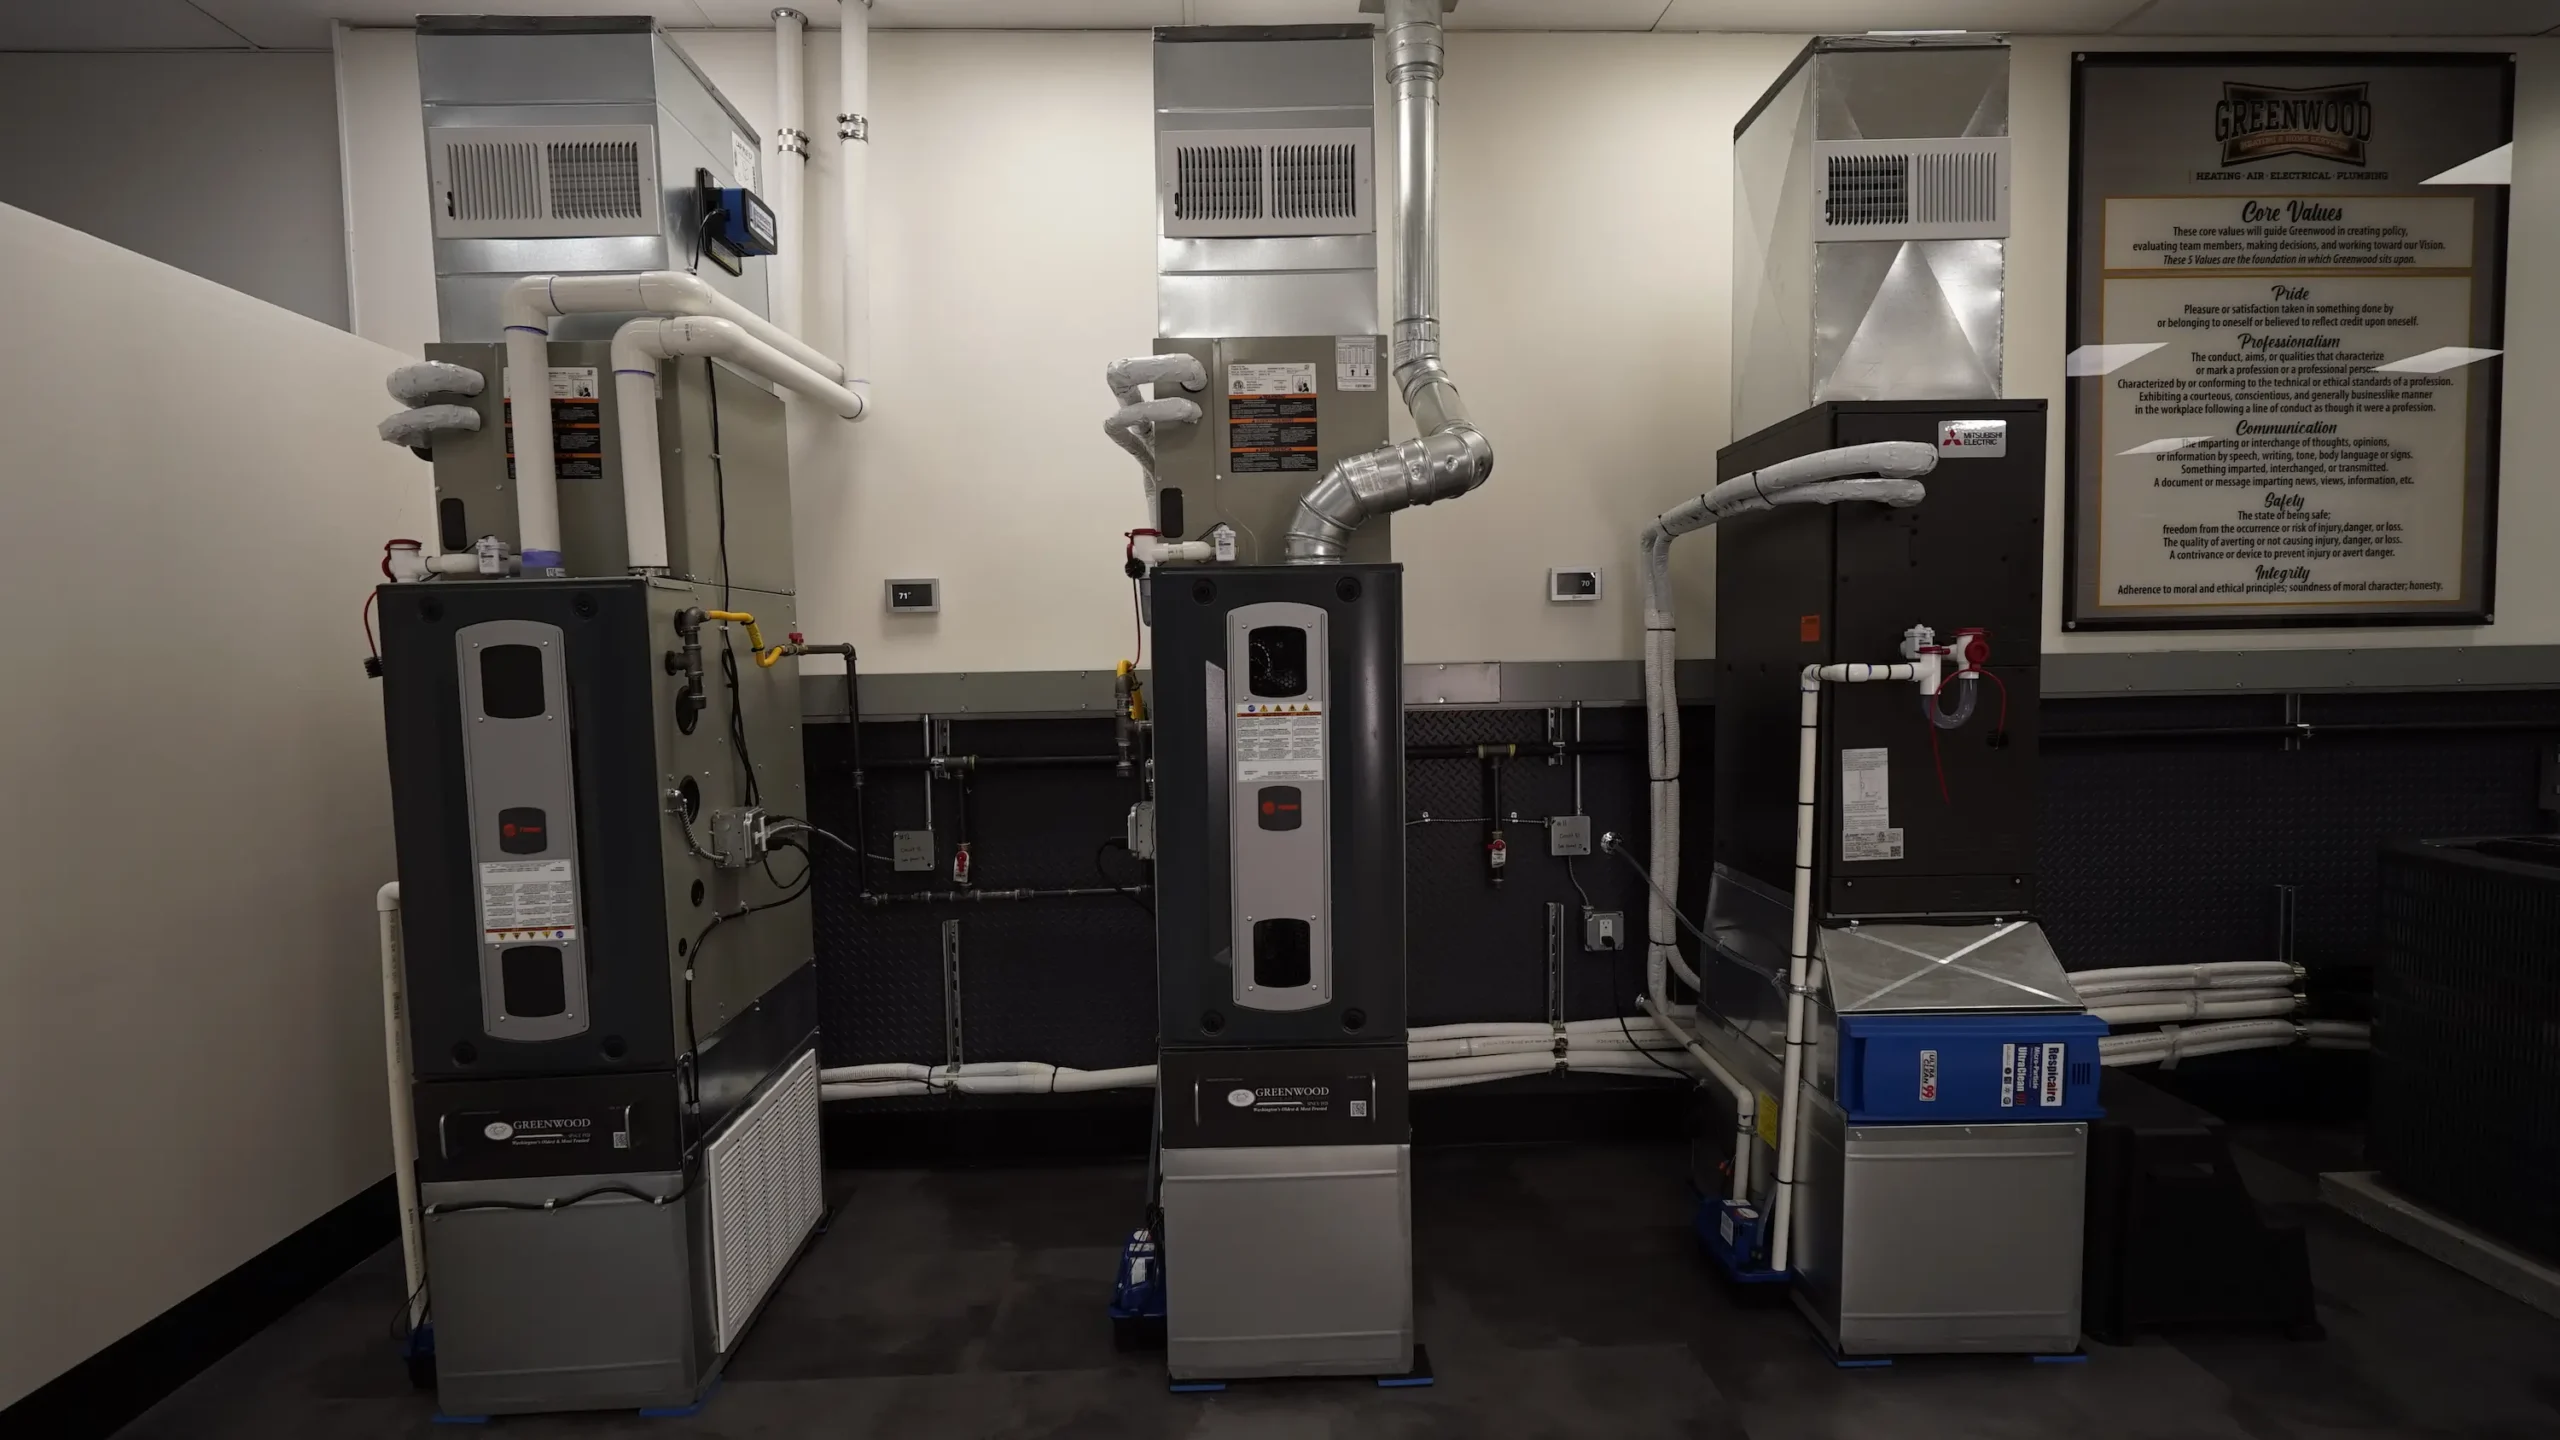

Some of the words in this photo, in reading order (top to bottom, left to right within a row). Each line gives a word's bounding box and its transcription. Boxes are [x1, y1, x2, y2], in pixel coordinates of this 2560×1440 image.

[2215, 99, 2373, 143] GREENWOOD
[2196, 172, 2240, 180] HEATING
[2246, 172, 2264, 180] AIR
[2270, 172, 2331, 180] ELECTRICAL
[2336, 172, 2388, 180] PLUMBING
[2242, 200, 2280, 223] Core
[2286, 200, 2342, 223] Values
[2173, 226, 2198, 236] These
[2218, 226, 2246, 236] values
[2246, 226, 2262, 236] will
[2264, 226, 2287, 238] guide
[2289, 226, 2336, 236] Greenwood
[2337, 226, 2345, 235] in
[2347, 226, 2380, 238] creating
[2382, 226, 2408, 238] policy,
[2132, 241, 2178, 253] evaluating
[2180, 242, 2201, 250] team
[2203, 240, 2245, 251] members,
[2246, 240, 2278, 252] making
[2280, 240, 2319, 251] decisions,
[2321, 240, 2337, 250] and
[2338, 240, 2372, 252] working
[2374, 240, 2402, 250] toward
[2404, 242, 2418, 250] our
[2419, 240, 2445, 250] Vision.
[2164, 255, 2186, 264] These
[2188, 255, 2193, 264] 5
[2195, 255, 2221, 264] Values
[2237, 254, 2251, 264] the
[2252, 254, 2296, 264] foundation
[2298, 254, 2306, 263] in
[2308, 254, 2332, 264] which
[2333, 254, 2378, 264] Greenwood
[2379, 254, 2392, 263] sits
[2394, 256, 2416, 266] upon.
[2271, 285, 2309, 301] Pride
[2184, 304, 2220, 314] Pleasure
[2221, 306, 2230, 314] or
[2232, 304, 2280, 314] satisfaction
[2282, 304, 2304, 313] taken
[2306, 304, 2314, 313] in
[2316, 304, 2360, 315] something
[2362, 304, 2382, 313] done
[2384, 304, 2394, 315] by
[2238, 333, 2340, 352] Professionalism
[2191, 352, 2206, 362] The
[2208, 352, 2243, 362] conduct,
[2245, 352, 2267, 362] aims,
[2279, 352, 2315, 361] qualities
[2316, 351, 2334, 361] that
[2335, 351, 2384, 361] characterize
[2118, 379, 2174, 388] Characterized
[2176, 378, 2186, 390] by
[2188, 380, 2197, 388] or
[2198, 378, 2246, 390] conforming
[2248, 379, 2256, 387] to
[2258, 378, 2272, 387] the
[2274, 377, 2310, 387] technical
[2323, 377, 2350, 386] ethical
[2352, 376, 2392, 386] standards
[2393, 376, 2402, 386] of
[2410, 376, 2453, 388] profession.
[2140, 392, 2181, 403] Exhibiting
[2190, 392, 2233, 401] courteous,
[2234, 392, 2292, 400] conscientious,
[2294, 390, 2310, 400] and
[2311, 390, 2350, 402] generally
[2351, 389, 2400, 399] businesslike
[2236, 420, 2337, 436] Communication
[2181, 464, 2226, 476] Something
[2228, 464, 2268, 475] imparted,
[2270, 463, 2326, 475] interchanged,
[2338, 462, 2388, 472] transmitted.
[2154, 478, 2160, 487] A
[2161, 478, 2203, 487] document
[2216, 479, 2251, 488] message
[2252, 476, 2293, 488] imparting
[2295, 478, 2319, 486] news,
[2320, 476, 2346, 486] views,
[2348, 475, 2398, 485] information,
[2400, 476, 2414, 484] etc.
[2264, 492, 2304, 510] Safety
[2238, 511, 2253, 520] The
[2254, 512, 2275, 520] state
[2276, 510, 2286, 520] of
[2286, 510, 2310, 522] being
[2311, 510, 2331, 520] safe;
[2163, 524, 2198, 534] freedom
[2199, 524, 2219, 533] from
[2220, 524, 2234, 533] the
[2292, 522, 2306, 532] risk
[2308, 522, 2317, 532] of
[2386, 522, 2403, 531] loss.
[2170, 550, 2176, 559] A
[2177, 550, 2224, 560] contrivance
[2236, 549, 2262, 558] device
[2264, 550, 2272, 558] to
[2274, 550, 2305, 560] prevent
[2307, 548, 2331, 560] injury
[2342, 549, 2364, 557] avert
[2365, 548, 2395, 559] danger.
[2256, 565, 2310, 584] Integrity
[2118, 585, 2162, 594] Adherence
[2163, 586, 2172, 594] to
[2173, 584, 2198, 593] moral
[2199, 583, 2215, 593] and
[2216, 583, 2244, 593] ethical
[2246, 583, 2288, 594] principles;
[2289, 582, 2332, 592] soundness
[2332, 582, 2342, 591] of
[2343, 582, 2366, 591] moral
[2368, 581, 2408, 591] character;
[2409, 581, 2443, 592] honesty.
[2016, 1046, 2028, 1092] UltraClean
[2047, 1047, 2059, 1102] Respicaire
[1255, 1086, 1329, 1097] GREENWOOD
[1922, 1085, 1934, 1098] 99
[513, 1118, 591, 1129] GREENWOOD
